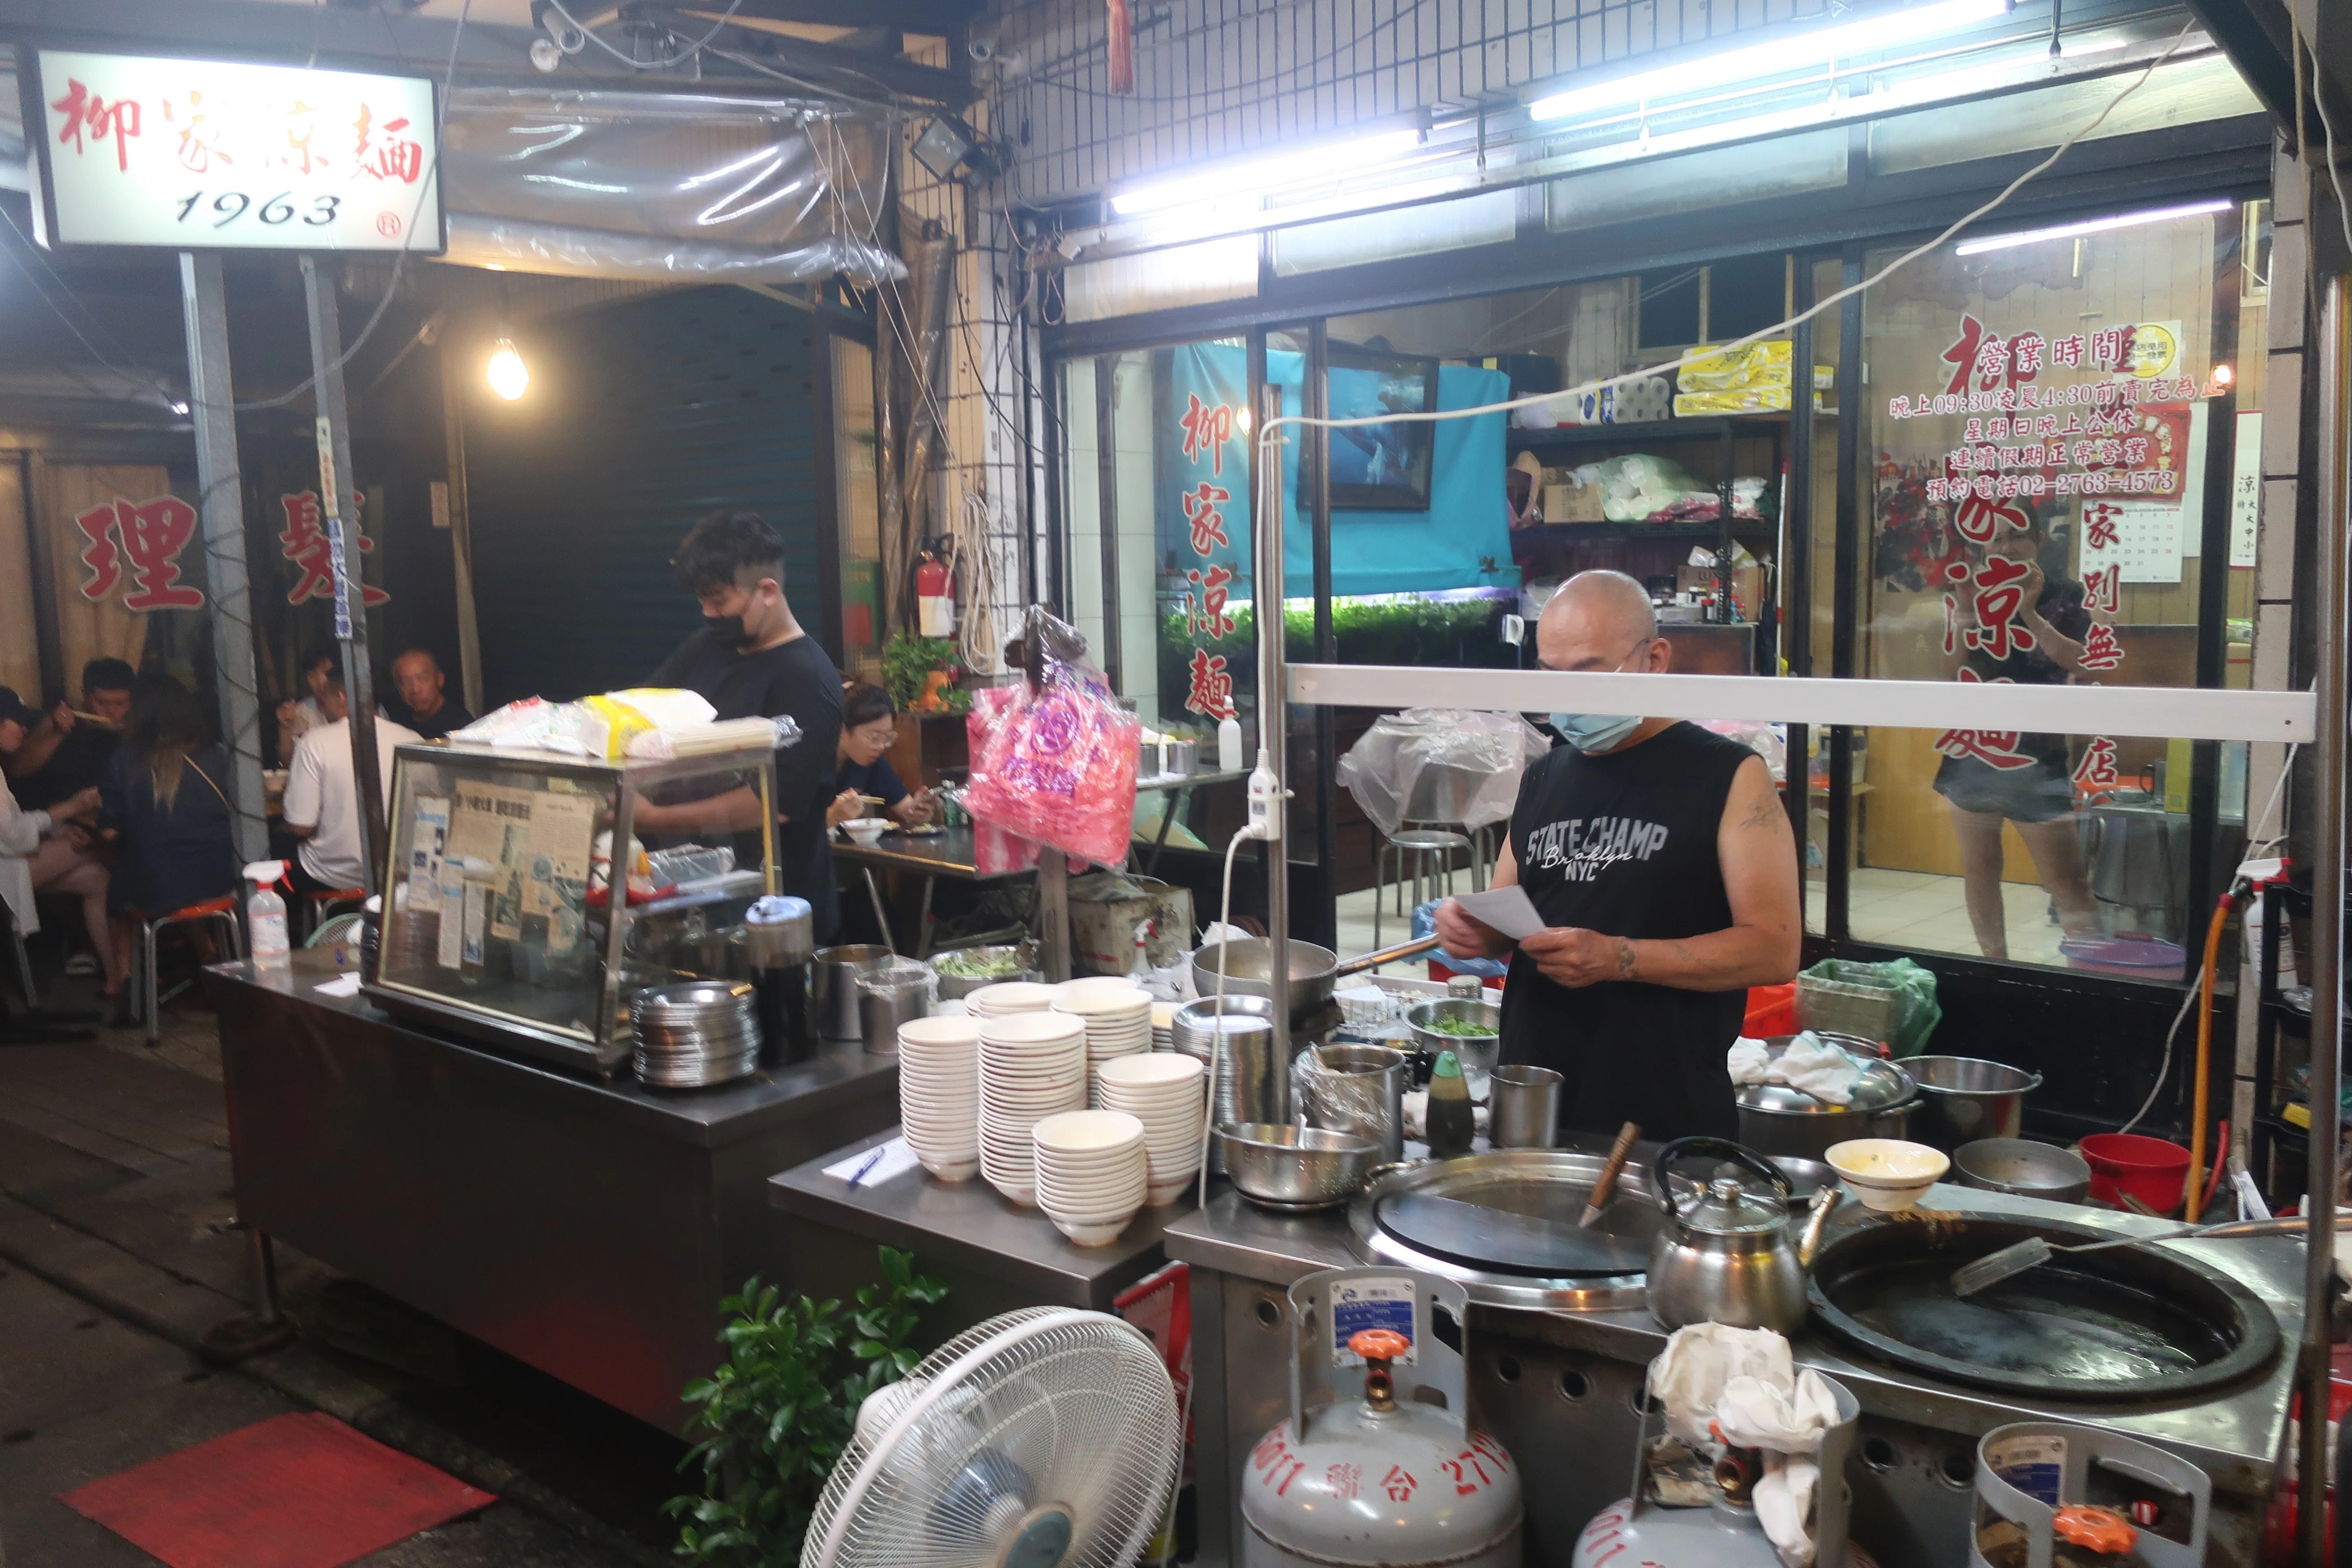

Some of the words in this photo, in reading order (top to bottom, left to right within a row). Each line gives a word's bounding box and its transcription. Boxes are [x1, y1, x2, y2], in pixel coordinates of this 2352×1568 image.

[176, 191, 341, 228] 1963
[1980, 329, 2122, 377] 營業時間
[1965, 409, 2136, 443] 星期日晚上公休
[1950, 437, 2148, 471] 連續假期正常營業
[1926, 471, 2174, 501] 預約電話02-2763-4573
[1525, 818, 1582, 865] STATE
[1581, 816, 1669, 862] CHAMP
[1540, 844, 1633, 871] Broklyn
[1564, 861, 1600, 882] NYC
